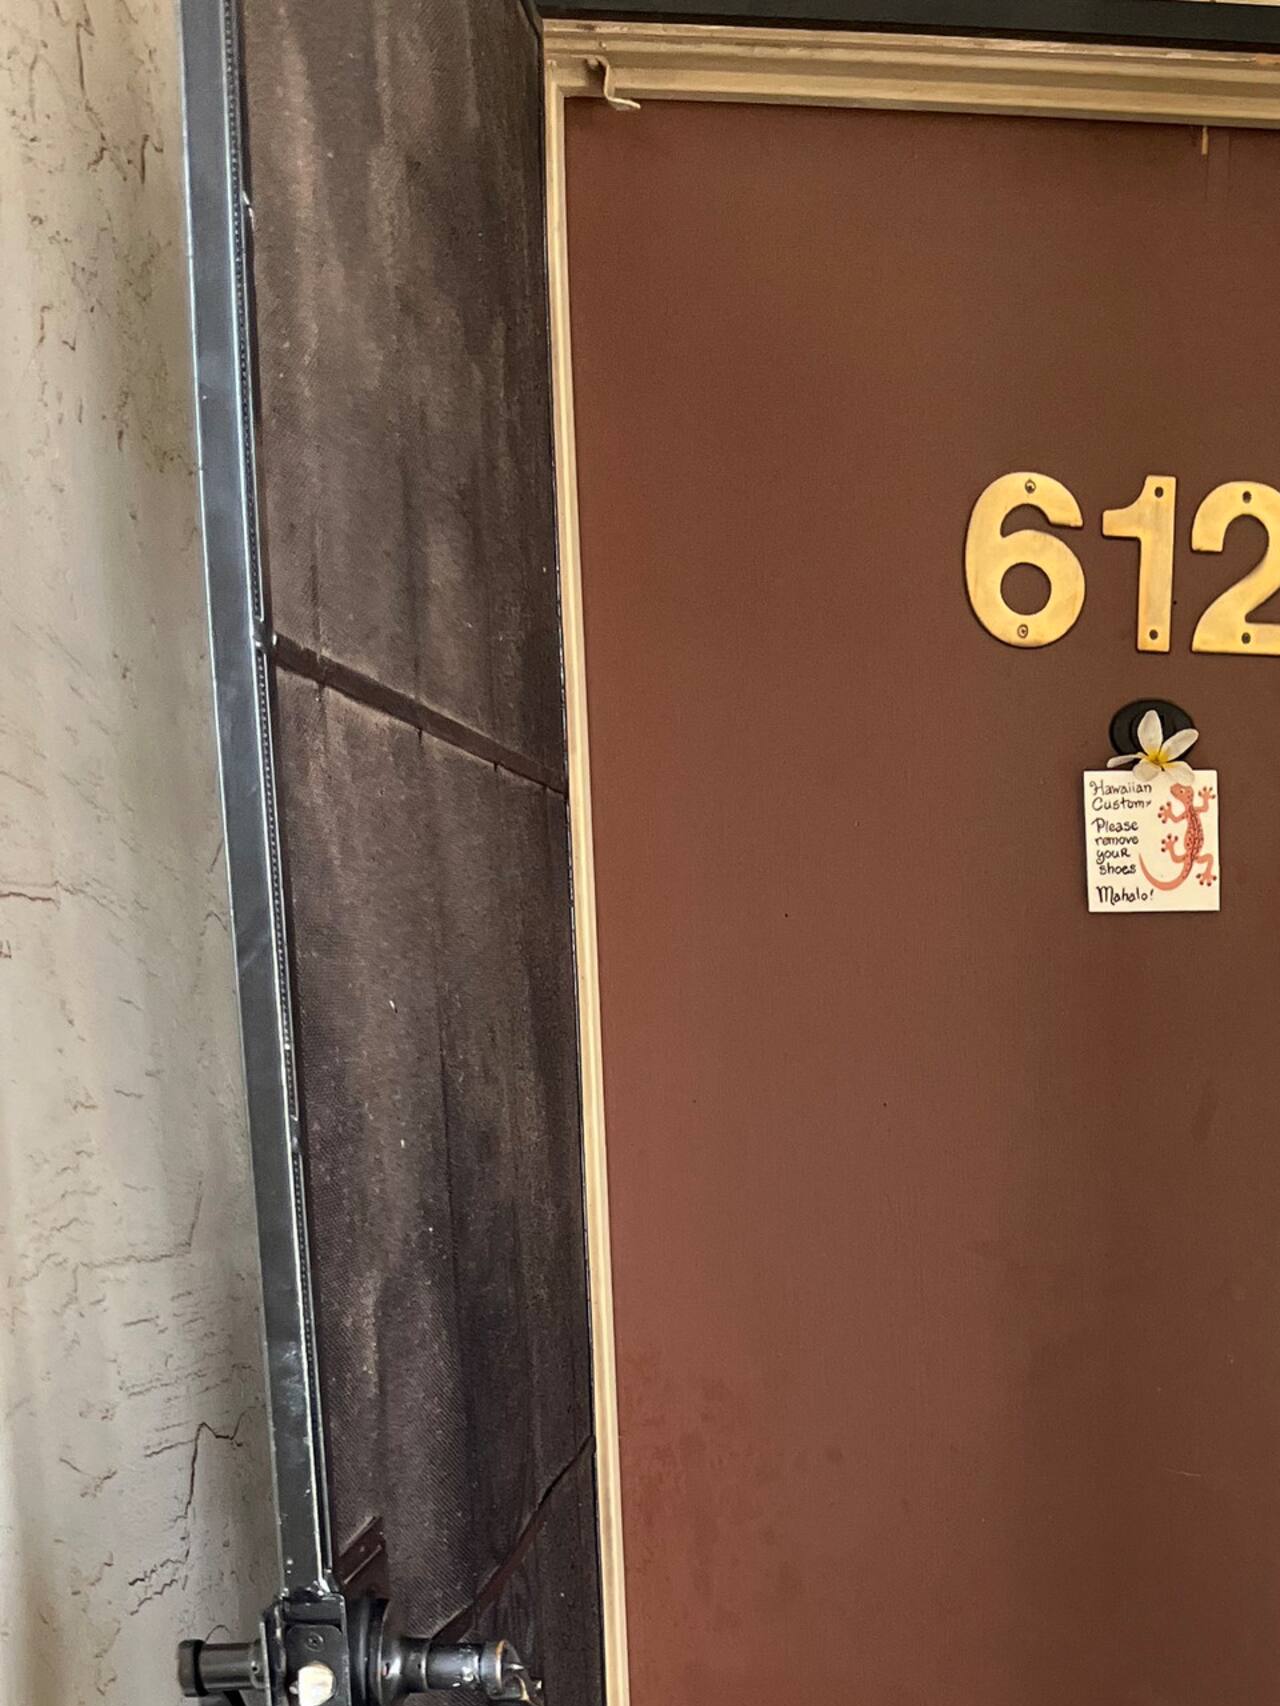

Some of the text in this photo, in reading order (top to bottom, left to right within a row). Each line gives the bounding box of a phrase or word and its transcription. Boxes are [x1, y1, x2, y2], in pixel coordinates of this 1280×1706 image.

[1089, 779, 1152, 796] Hawaiian
[1091, 817, 1139, 833] Please
[1094, 836, 1139, 846] remove
[1098, 862, 1137, 875] shoes
[1096, 885, 1154, 906] Mahalo!
